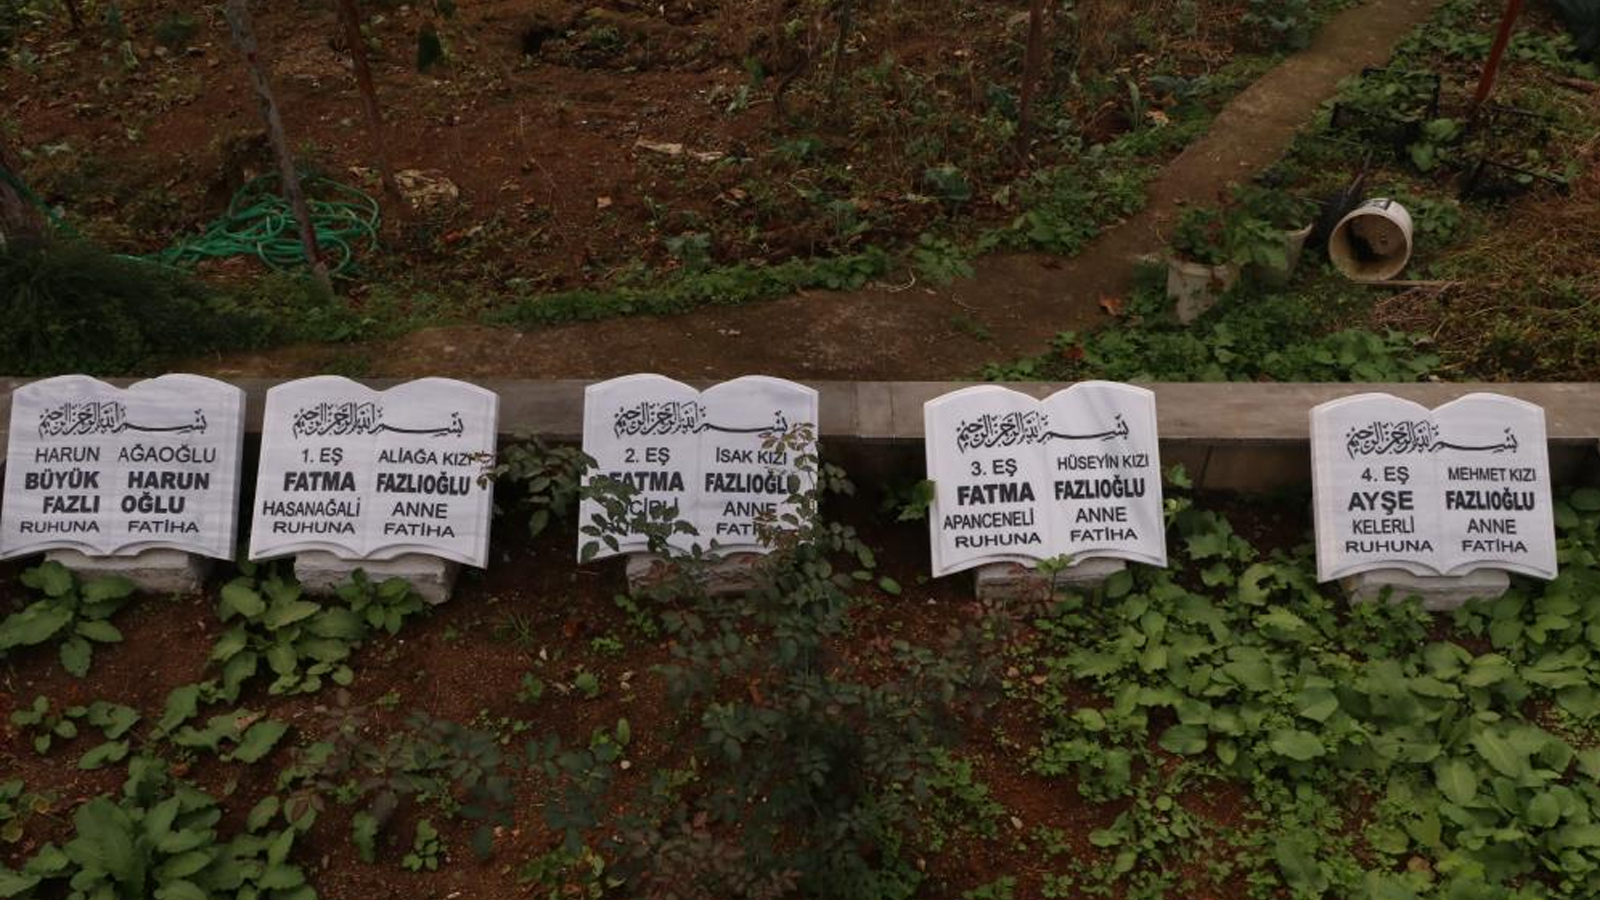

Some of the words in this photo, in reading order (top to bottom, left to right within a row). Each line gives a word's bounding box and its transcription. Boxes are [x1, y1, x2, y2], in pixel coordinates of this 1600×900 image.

[35, 447, 100, 463] HARUN
[118, 444, 216, 463] AĞAOĞLU
[302, 449, 314, 463] 1.
[320, 447, 343, 466] EŞ
[378, 447, 437, 465] ALİAĞA
[442, 452, 474, 467] KIZI
[625, 448, 639, 463] 2.
[646, 447, 670, 466] EŞ
[716, 447, 753, 463] İSAK
[757, 450, 788, 465] KIZI
[971, 461, 986, 476] 3.
[993, 458, 1017, 477] EŞ
[1057, 453, 1119, 470] HÜSEYİN
[1122, 454, 1149, 468] KIZI
[1361, 468, 1377, 482] 4.
[1384, 466, 1409, 485] EŞ
[1448, 467, 1506, 481] MEHMET
[1509, 468, 1536, 482] KIZI
[25, 468, 100, 490] BÜYÜK
[128, 471, 209, 492] HARUN
[283, 471, 356, 491] FATMA
[376, 471, 470, 496] FAZLIOĞLU
[704, 470, 800, 495] FAZLIOĞL
[957, 482, 1035, 506] FATMA
[1054, 474, 1145, 500] FAZLIOĞLU
[43, 495, 100, 514] FAZLI
[121, 491, 185, 514] OĞLU
[263, 497, 360, 517] HASANAĞALİ
[392, 502, 448, 519] ANNE
[1348, 491, 1414, 517] AYŞE
[1446, 487, 1535, 511] FAZLIOĞLU
[20, 520, 100, 533] RUHUNA
[128, 519, 199, 533] FATİHA
[943, 508, 1034, 530] APANCENELİ
[1076, 507, 1127, 523] ANNE
[1352, 514, 1414, 534] KELERLİ
[1467, 518, 1517, 534] ANNE
[273, 521, 355, 534] RUHUNA
[384, 522, 455, 538] FATİHA
[955, 532, 1041, 548] RUHUNA
[1070, 527, 1138, 542] FATİHA
[1346, 540, 1433, 553] RUHUNA
[1462, 539, 1528, 553] FATİHA
